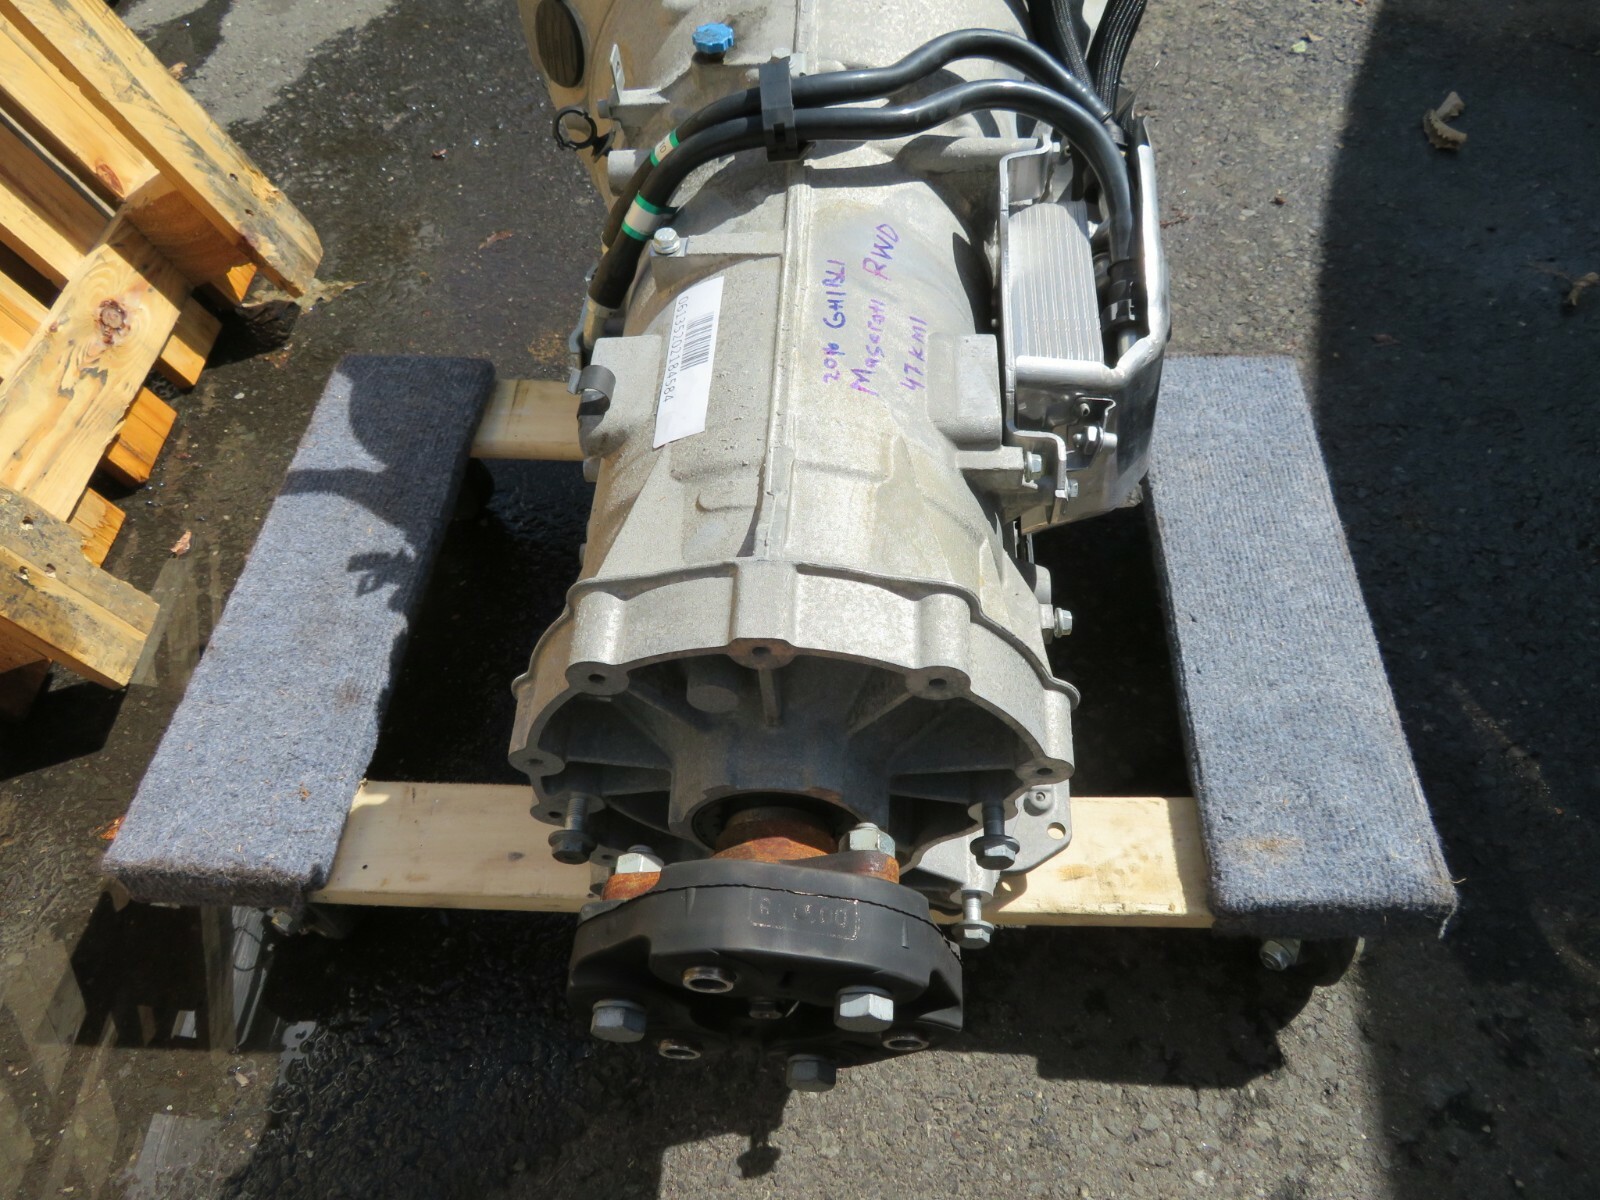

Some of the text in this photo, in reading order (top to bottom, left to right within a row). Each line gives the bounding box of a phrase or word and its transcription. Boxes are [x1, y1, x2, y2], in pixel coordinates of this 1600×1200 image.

[862, 223, 901, 281] RWD
[822, 259, 847, 329] GHIBLI
[662, 296, 689, 403] 06135202184584
